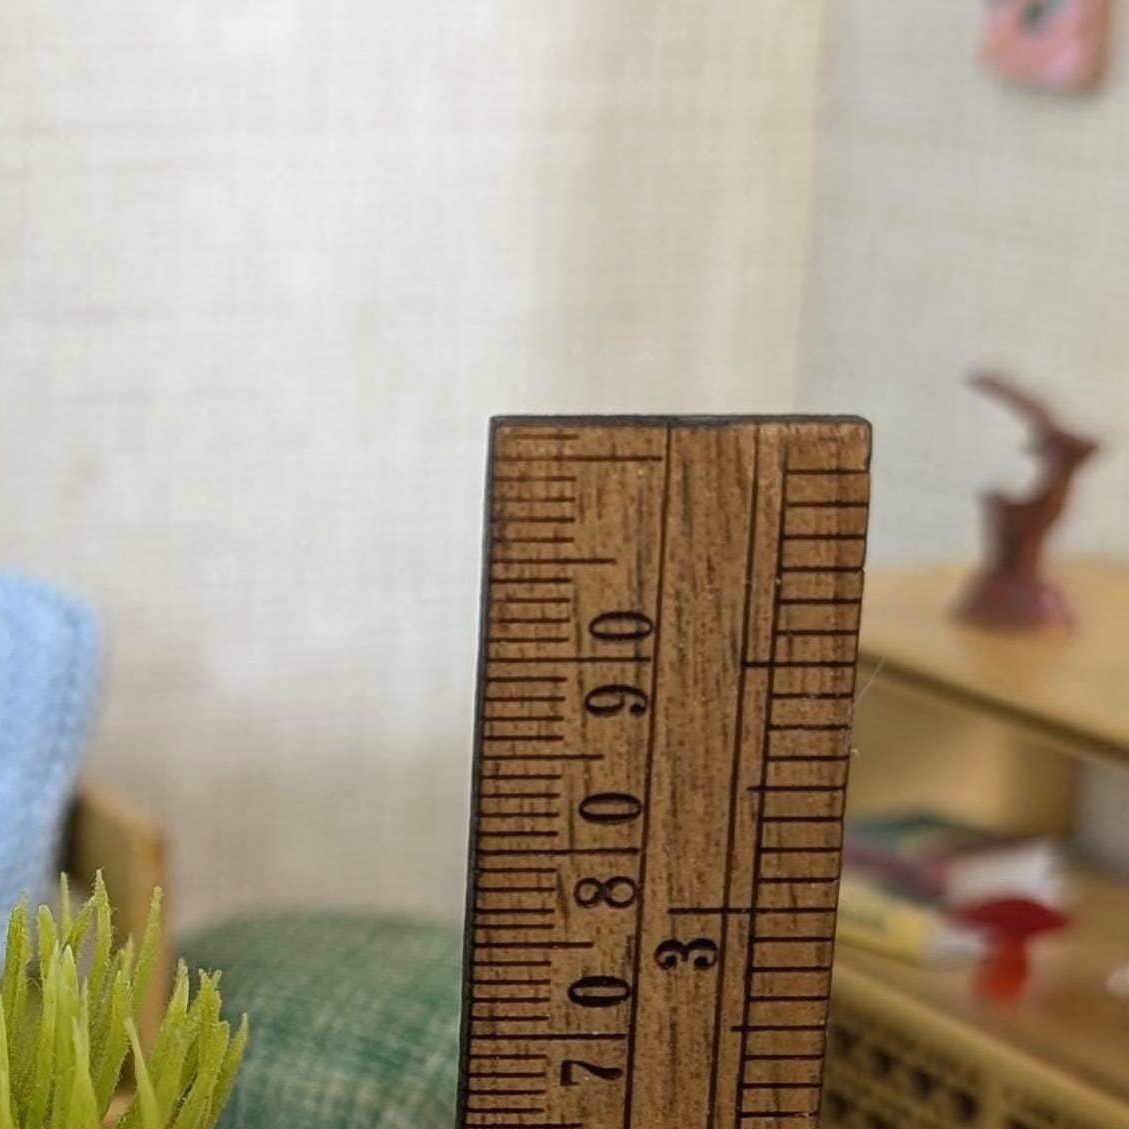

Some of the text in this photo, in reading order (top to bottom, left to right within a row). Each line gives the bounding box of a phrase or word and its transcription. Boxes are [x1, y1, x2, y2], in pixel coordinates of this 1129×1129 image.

[585, 611, 653, 716] 90
[573, 792, 643, 909] 80
[654, 938, 718, 971] 3
[560, 976, 632, 1087] 70
